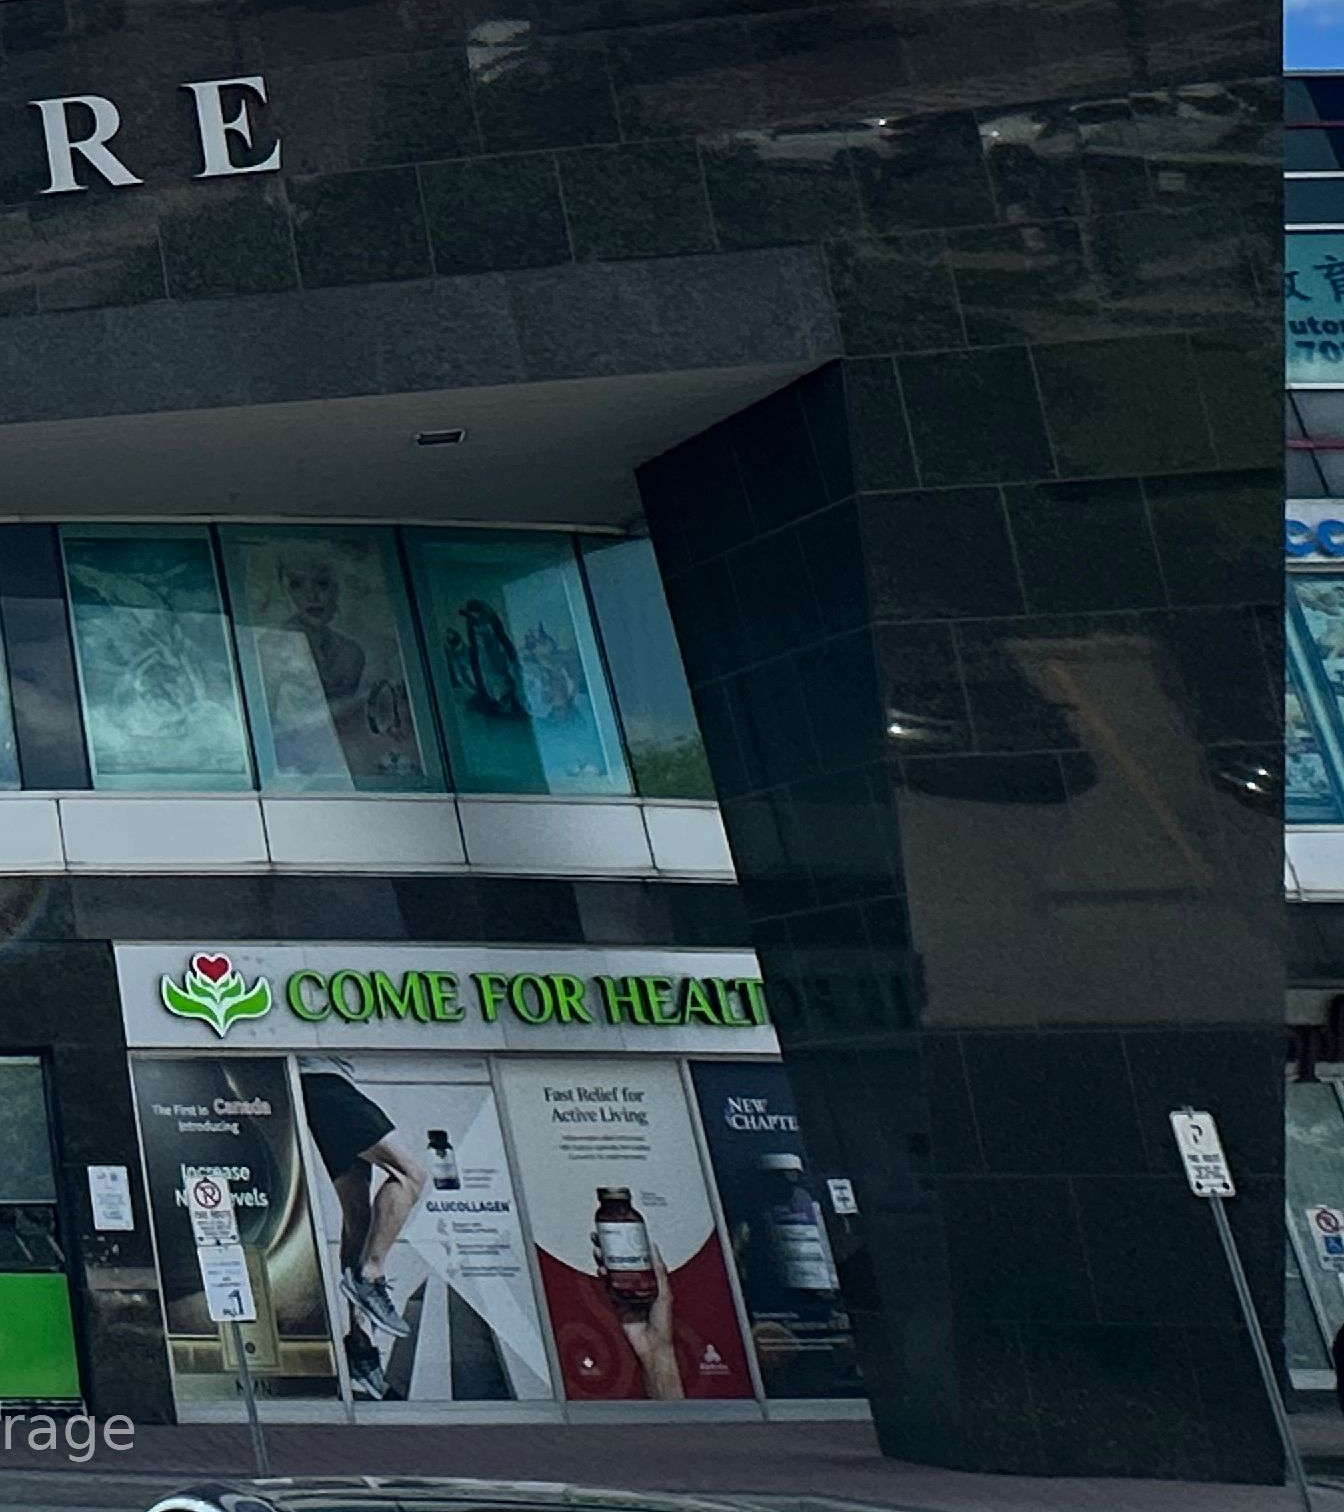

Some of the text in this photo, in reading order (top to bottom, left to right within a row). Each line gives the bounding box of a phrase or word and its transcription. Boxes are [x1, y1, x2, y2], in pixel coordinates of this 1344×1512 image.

[286, 968, 465, 1025] COME
[469, 972, 593, 1026] FOR
[543, 1086, 645, 1103] Fast Relief for
[213, 1096, 272, 1116] Canada
[727, 1096, 768, 1114] NEW
[552, 1105, 649, 1127] Active Living
[181, 1162, 251, 1181] Increase
